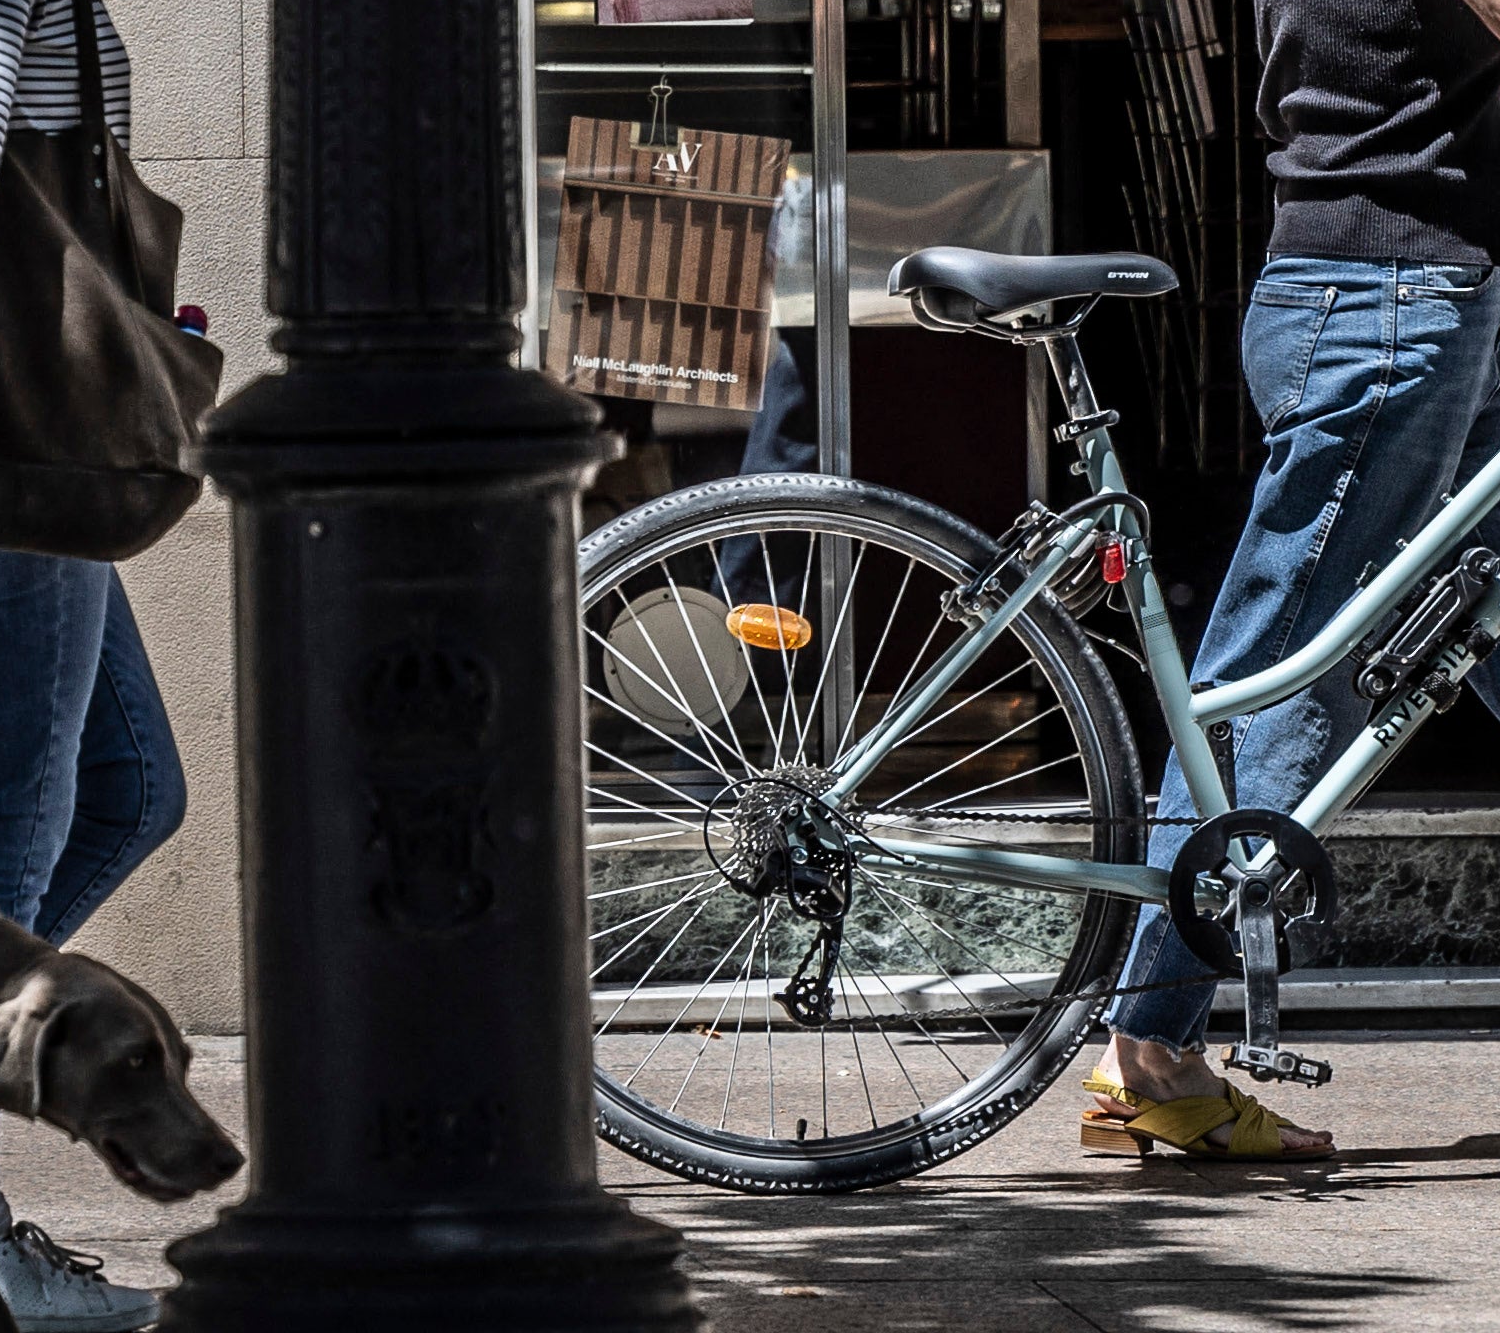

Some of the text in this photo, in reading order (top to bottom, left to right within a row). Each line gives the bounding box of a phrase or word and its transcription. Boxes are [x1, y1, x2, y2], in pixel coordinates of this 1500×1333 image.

[652, 142, 702, 173] AV
[572, 355, 738, 383] Niall McLaughlin Architects
